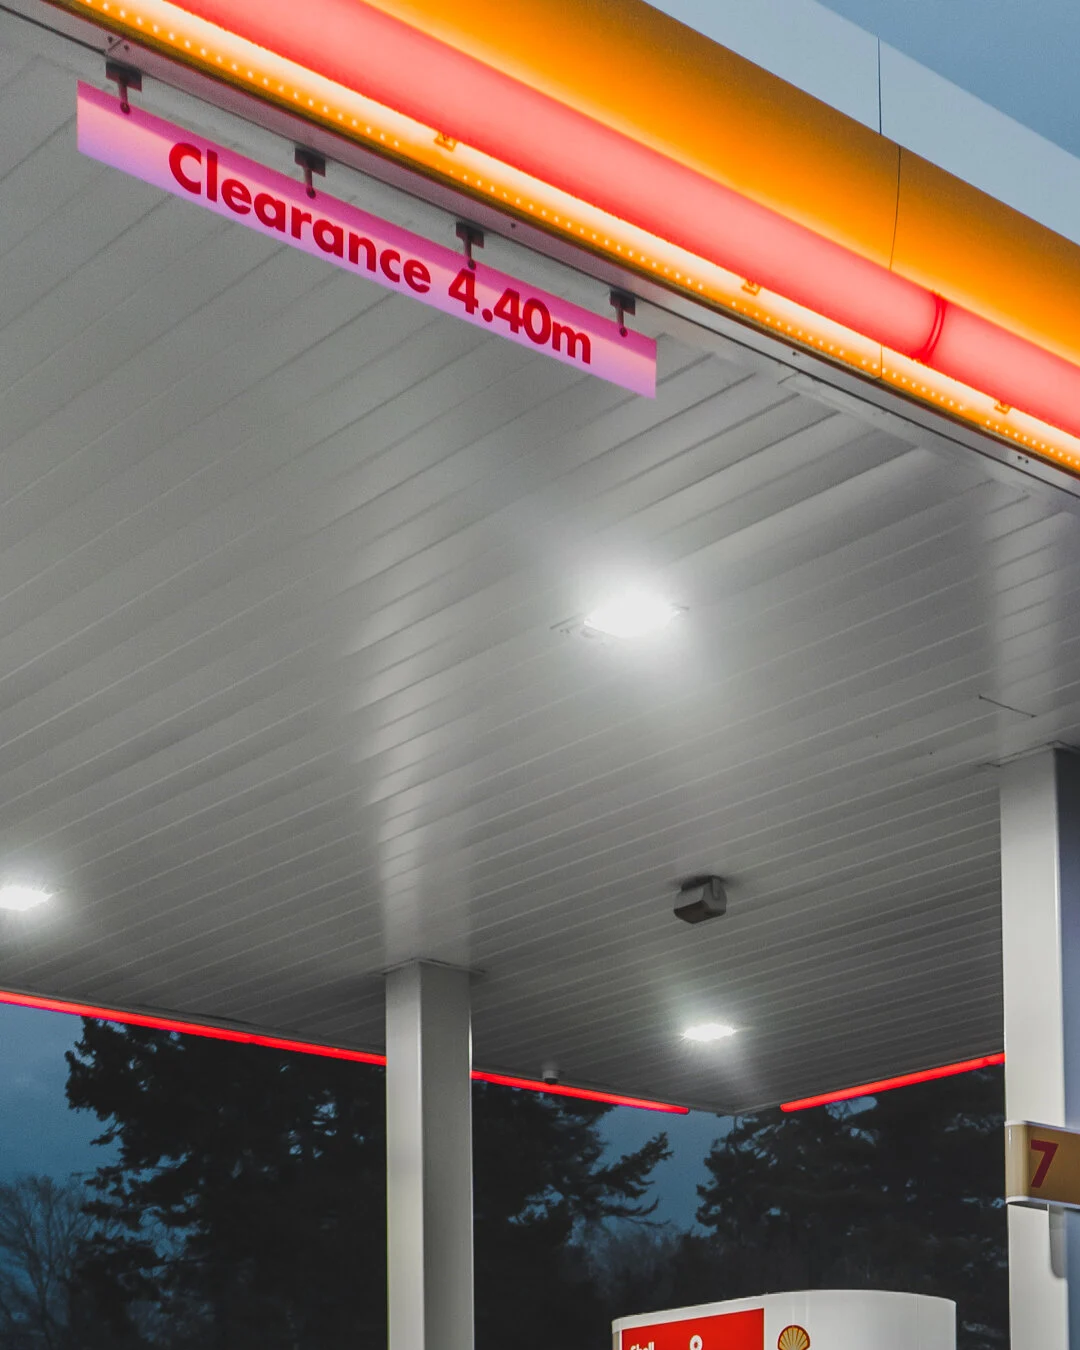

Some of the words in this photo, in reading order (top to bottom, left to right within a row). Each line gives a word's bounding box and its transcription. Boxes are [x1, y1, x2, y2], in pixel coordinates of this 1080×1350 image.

[168, 141, 431, 294] Clearance
[447, 268, 592, 365] 4.40m
[1030, 1139, 1060, 1189] 7
